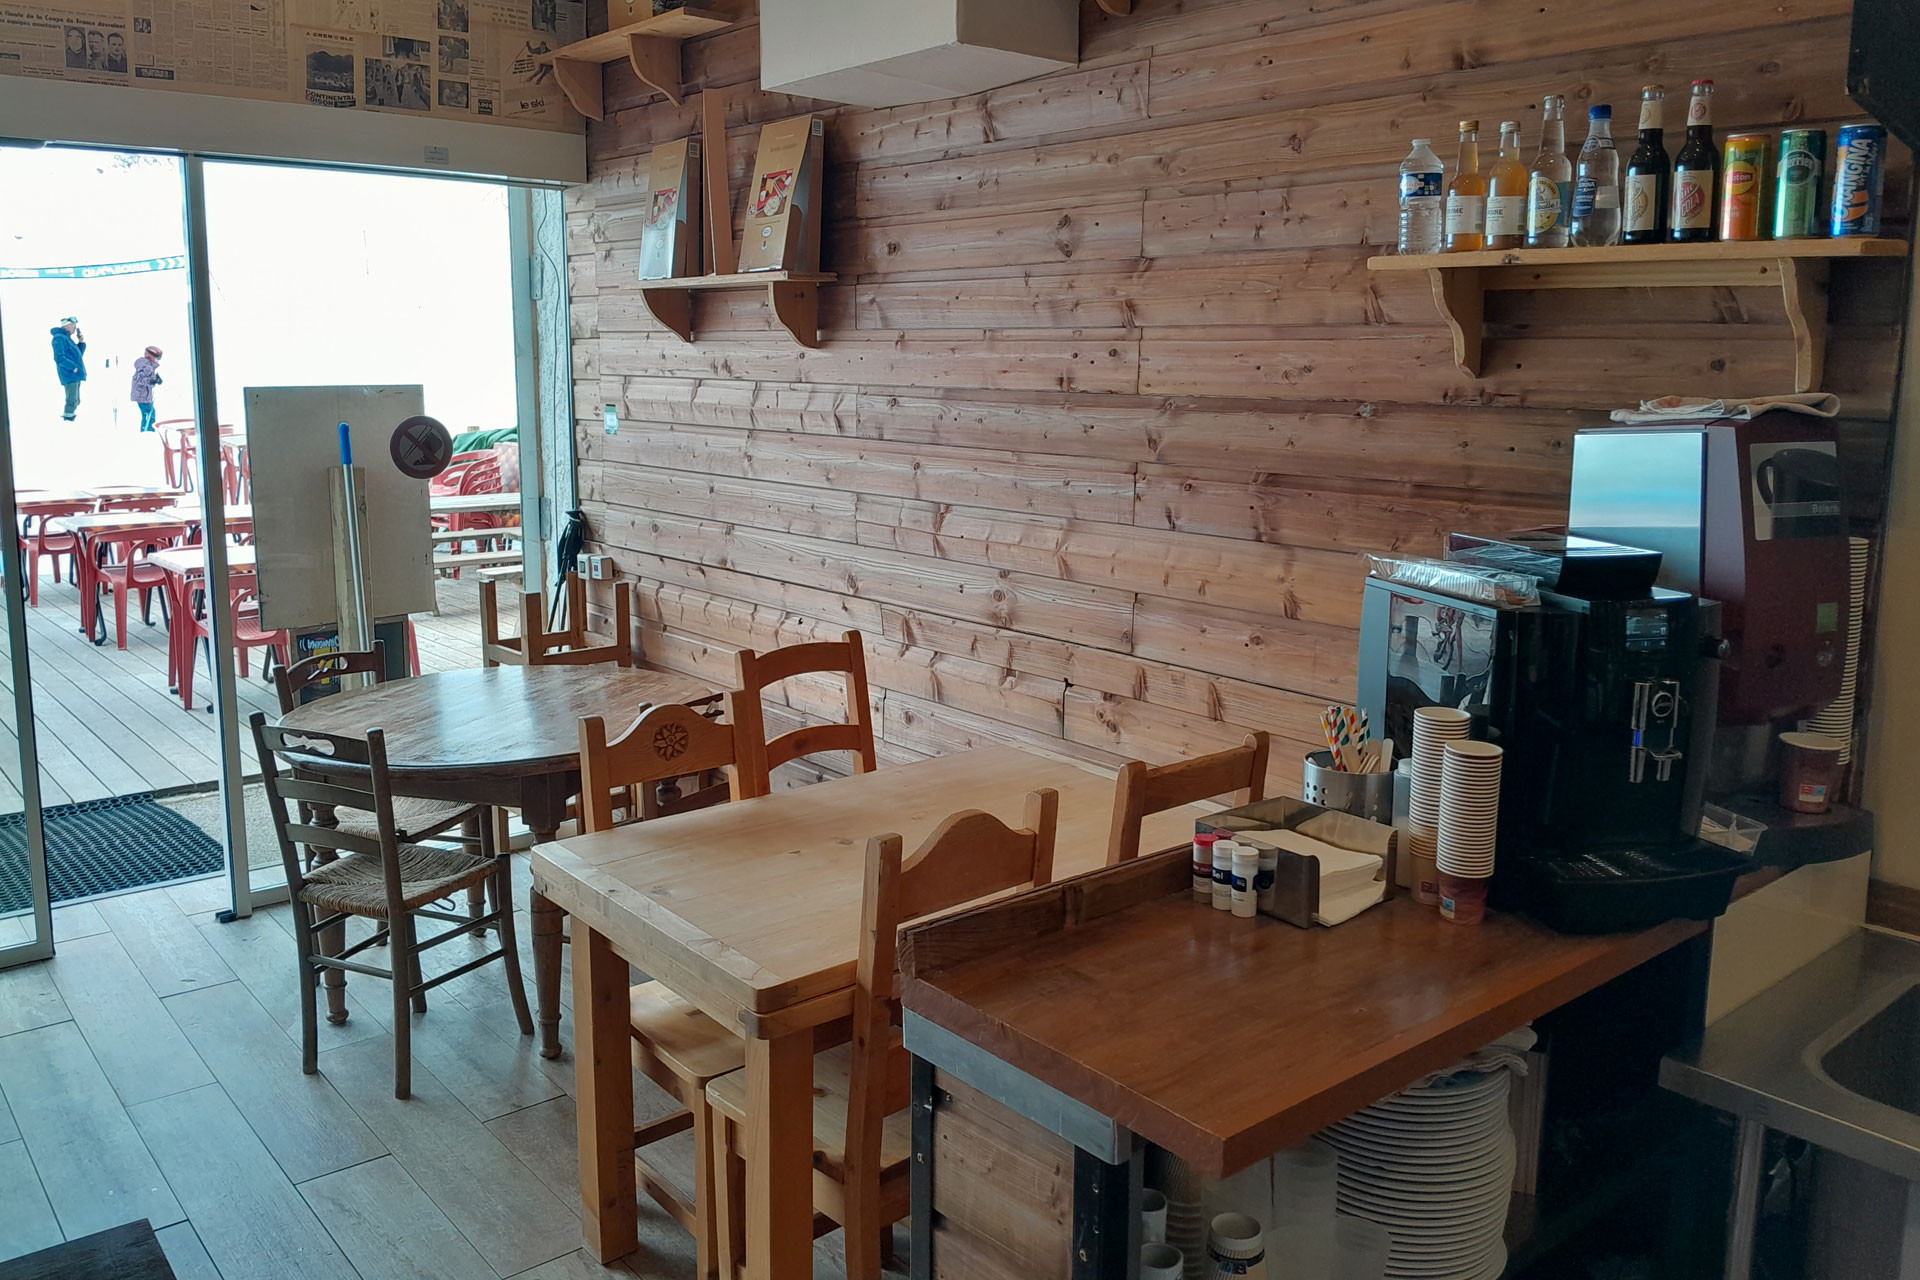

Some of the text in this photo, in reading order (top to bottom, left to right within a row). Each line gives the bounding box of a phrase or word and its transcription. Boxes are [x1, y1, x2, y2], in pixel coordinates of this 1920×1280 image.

[305, 90, 355, 101] CONTINENTAL
[520, 97, 545, 110] le ski
[1681, 193, 1700, 217] COLA
